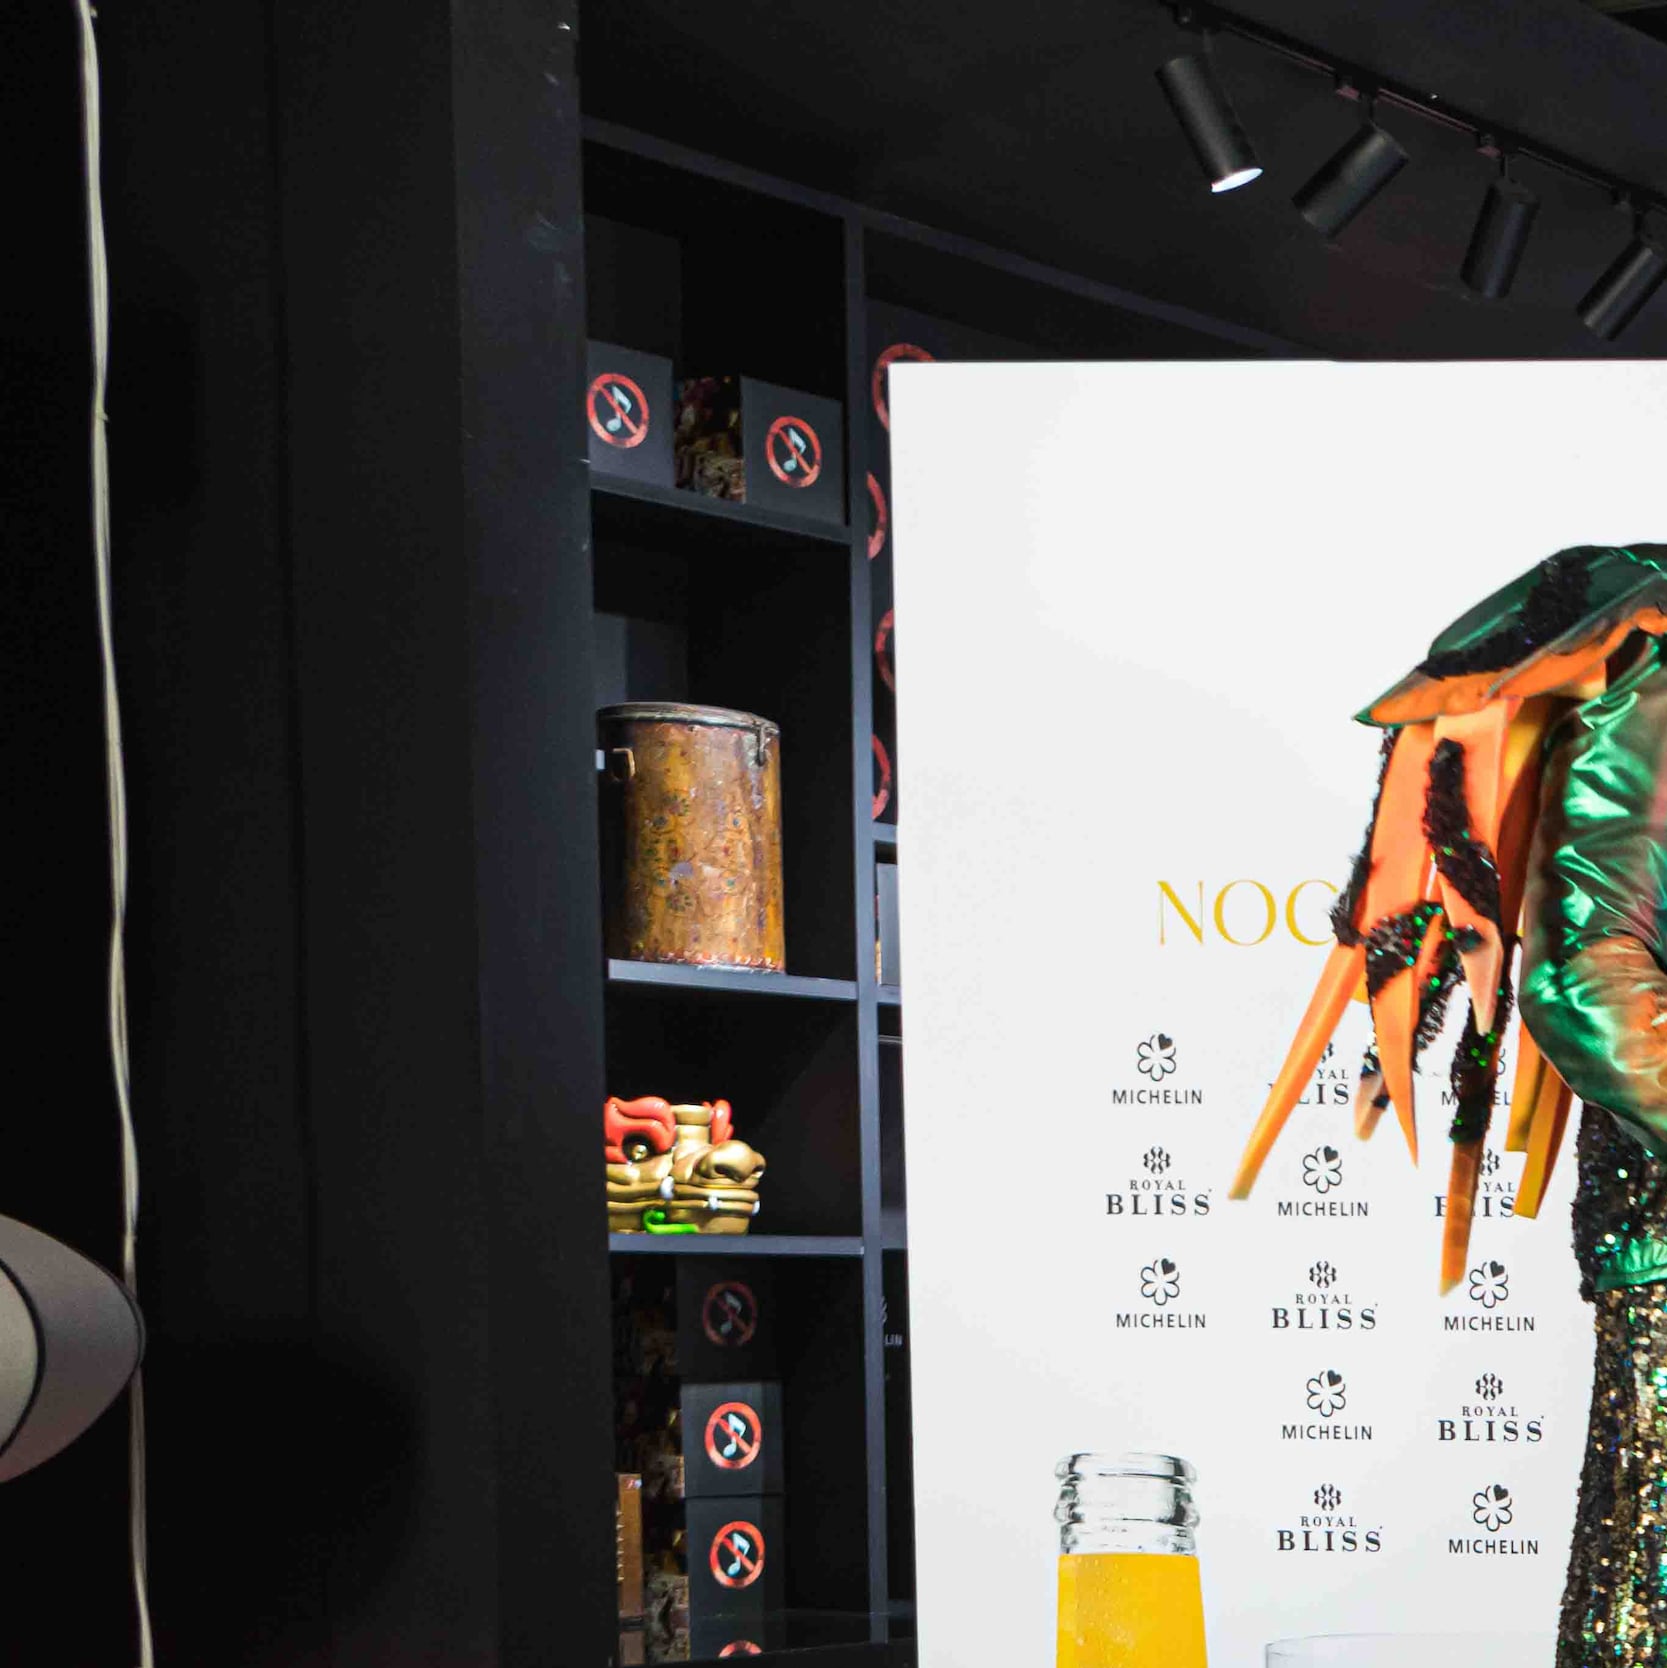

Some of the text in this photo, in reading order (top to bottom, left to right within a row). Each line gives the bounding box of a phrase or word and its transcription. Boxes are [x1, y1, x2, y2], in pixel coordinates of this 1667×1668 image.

[1156, 879, 1338, 947] NOC
[1113, 1089, 1202, 1104] MICHELIN
[1130, 1179, 1186, 1192] ROYAL
[1106, 1194, 1210, 1216] BLISS
[1278, 1201, 1368, 1216] MICHELIN
[1296, 1293, 1352, 1305] ROYAL
[1116, 1313, 1206, 1328] MICHELIN
[1272, 1308, 1376, 1330] BLISS
[1444, 1316, 1534, 1332] MICHELIN
[1462, 1406, 1518, 1417] ROYAL
[1282, 1424, 1372, 1440] MICHELIN
[1437, 1419, 1542, 1443] BLISS
[1300, 1516, 1357, 1529] ROYAL
[1277, 1530, 1381, 1552] BLISS
[1449, 1537, 1538, 1555] MICHELIN
